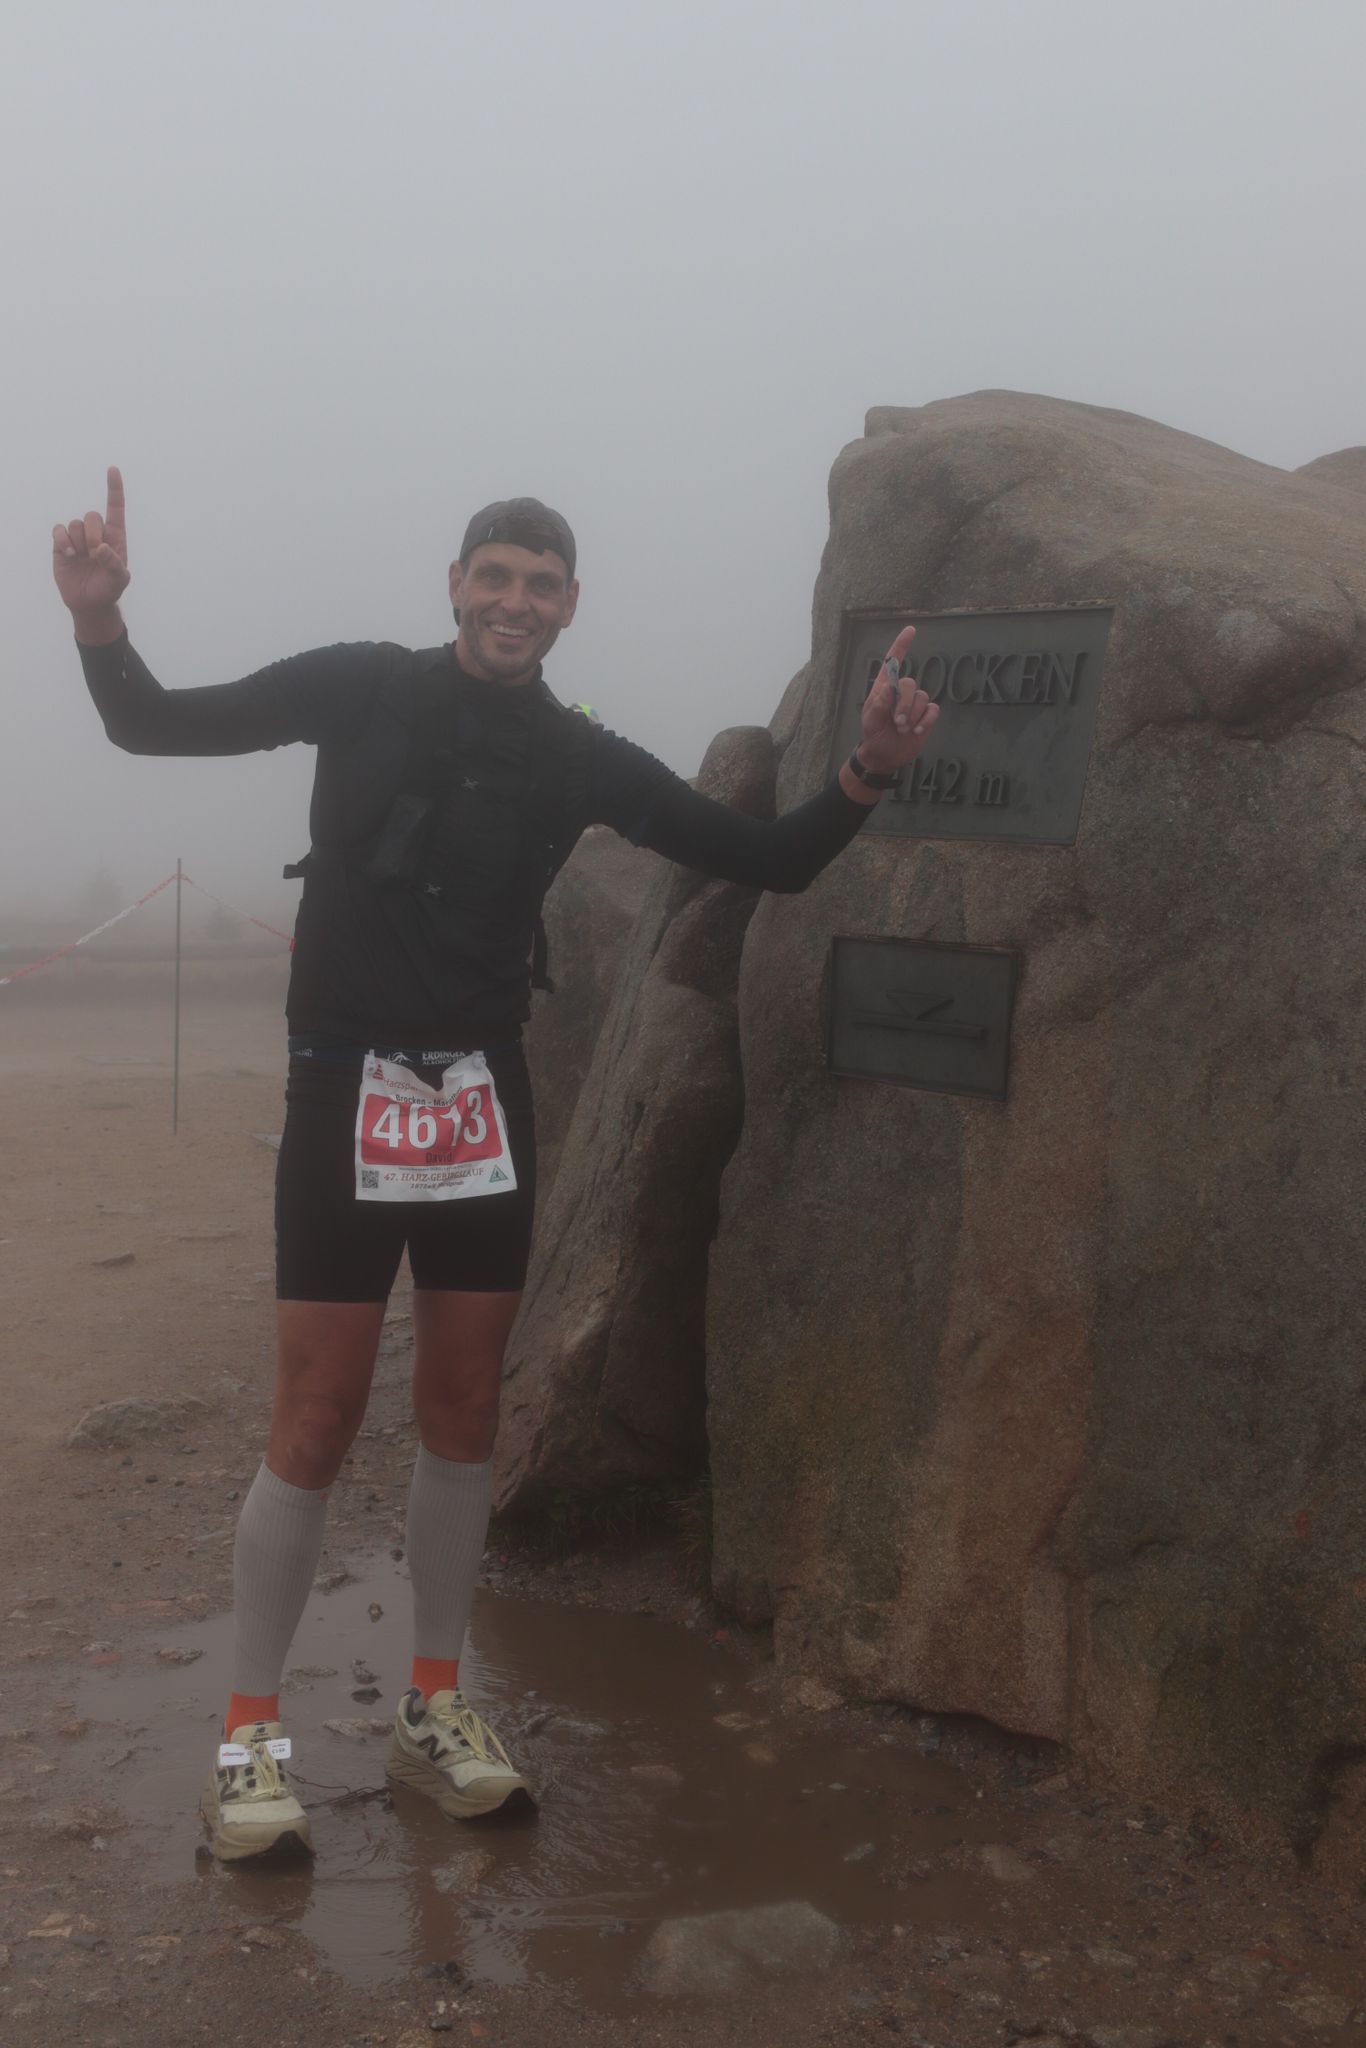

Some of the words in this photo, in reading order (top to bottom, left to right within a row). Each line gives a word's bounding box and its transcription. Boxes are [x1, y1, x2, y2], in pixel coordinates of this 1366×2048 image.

[975, 773, 1006, 805] m
[372, 1090, 487, 1149] 4613
[426, 1152, 453, 1163] David
